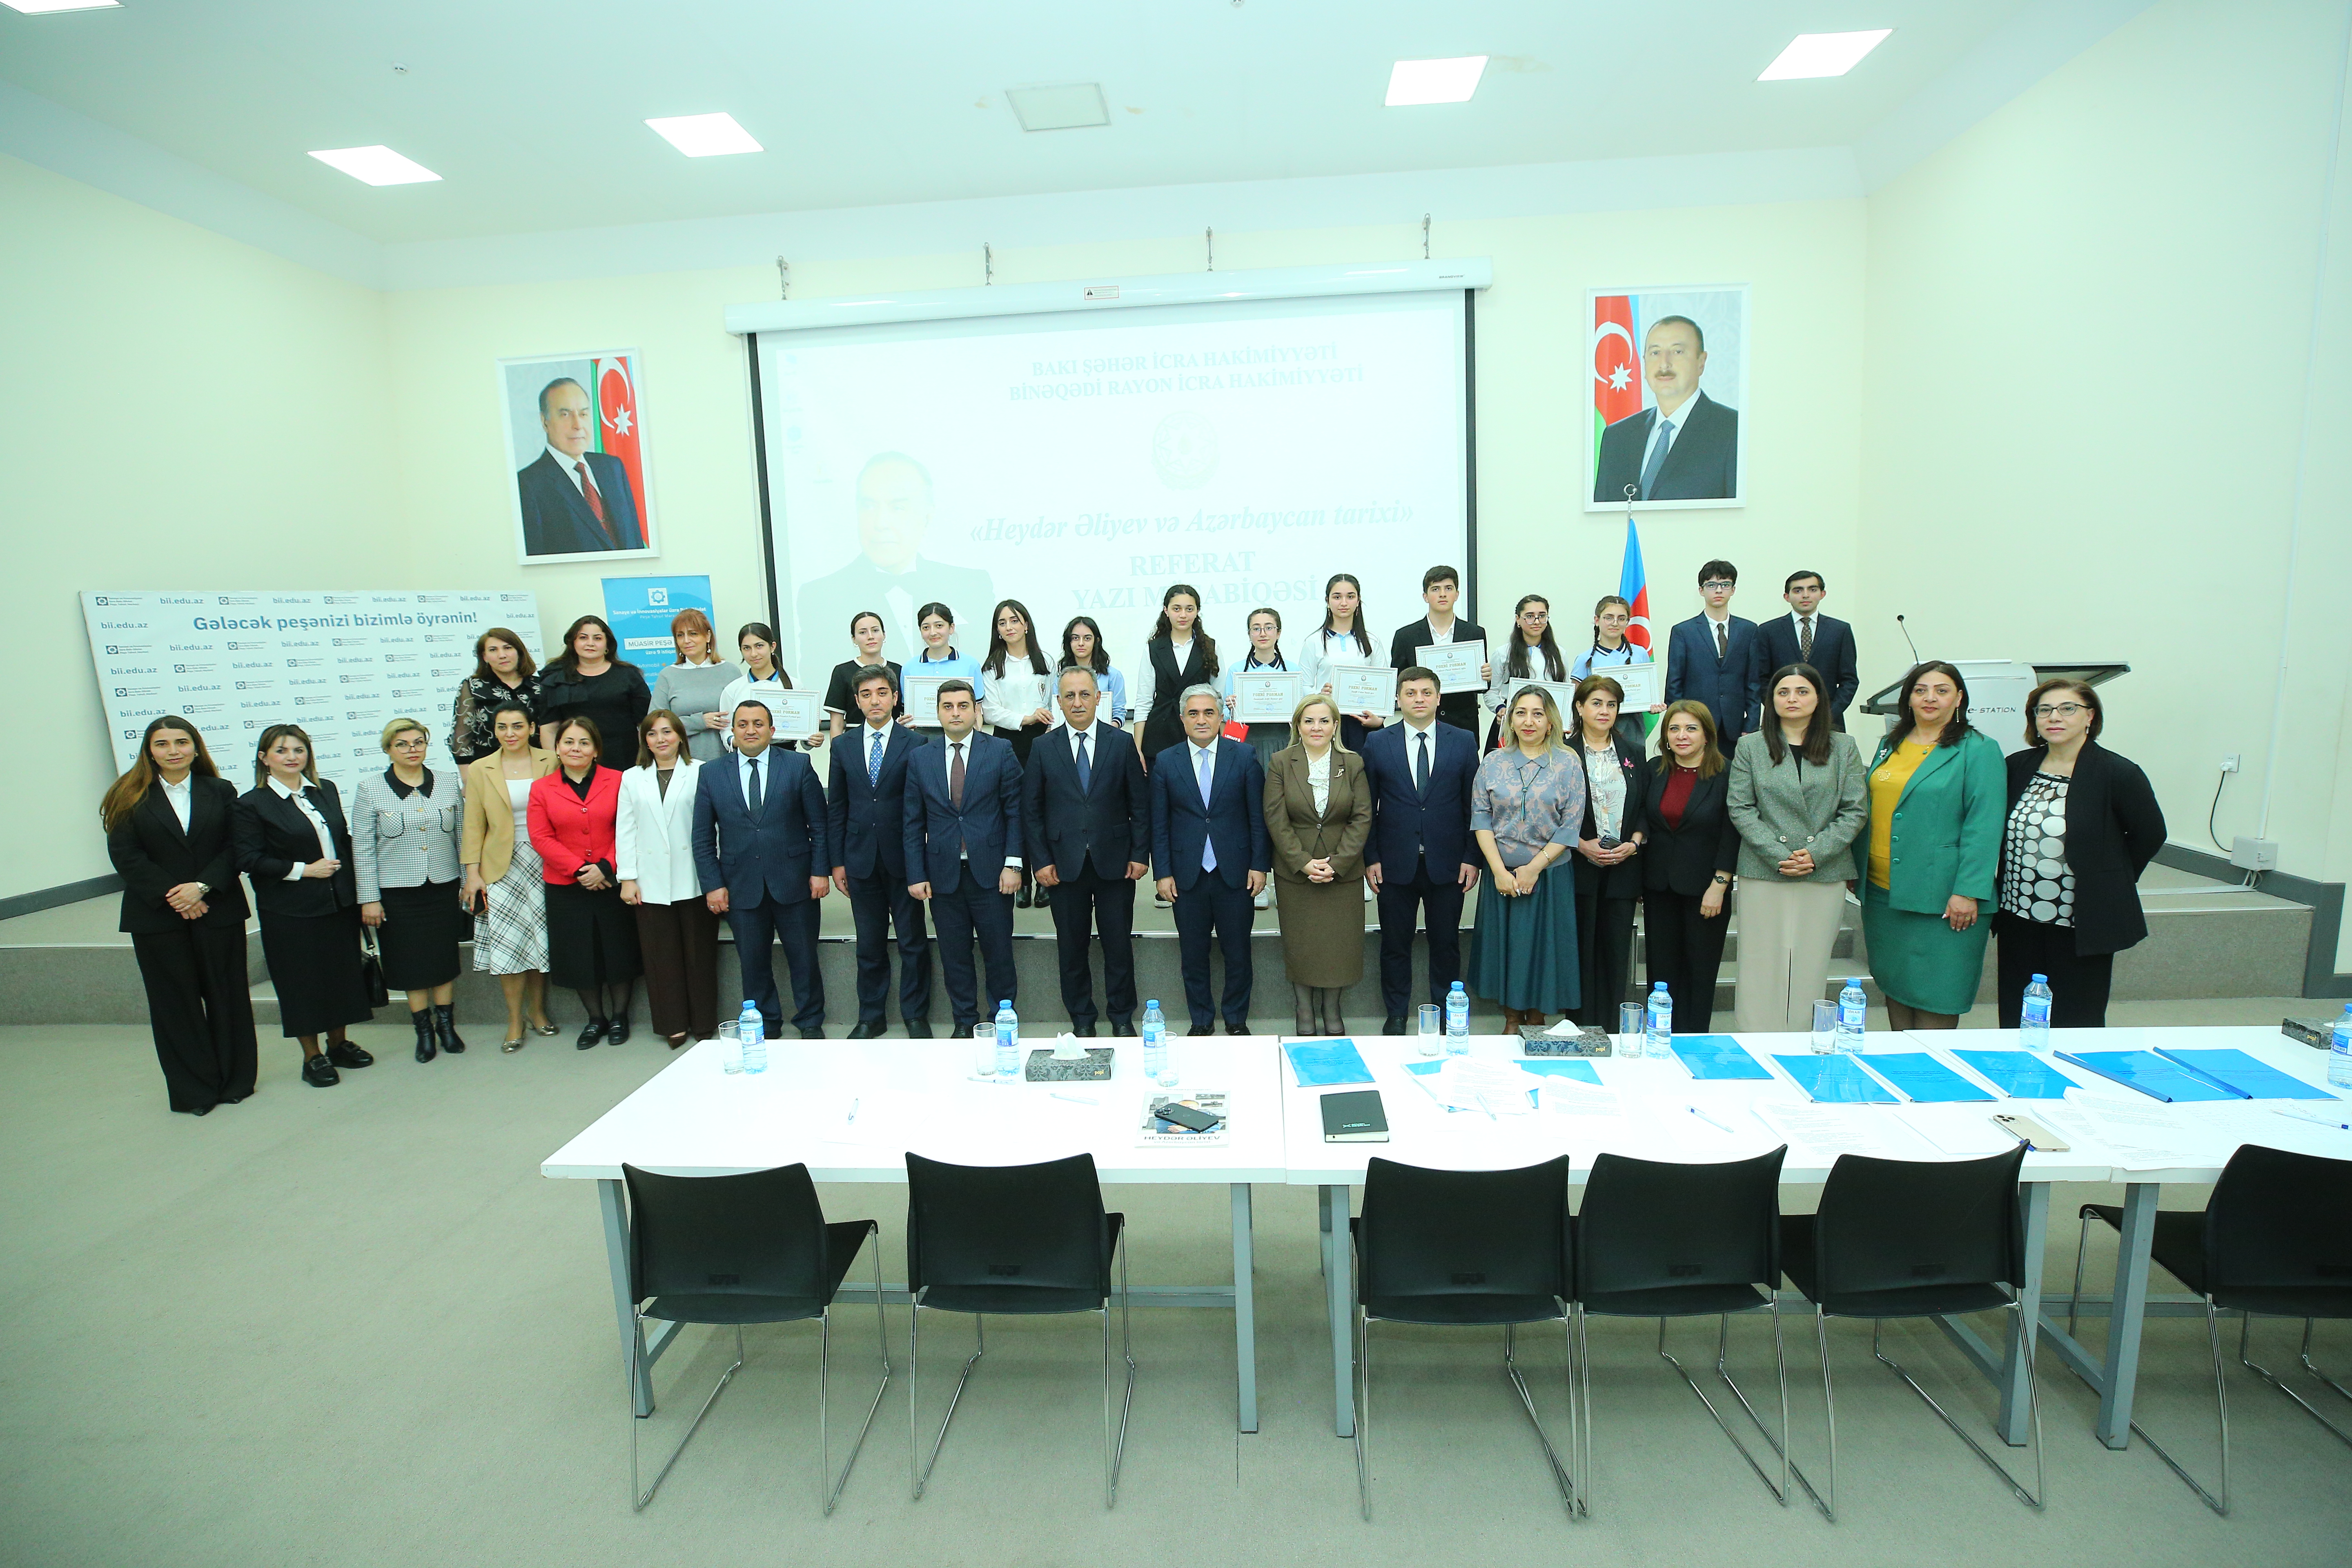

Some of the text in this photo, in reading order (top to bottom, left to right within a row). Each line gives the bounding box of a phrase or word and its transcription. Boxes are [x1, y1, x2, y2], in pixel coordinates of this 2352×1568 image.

[1032, 341, 1338, 378] BAKI ŞƏHƏR İCRA HAKİMİYYƏTİ
[1009, 363, 1364, 402] BİNƏQƏDİ RAYON İCRA HAKİMİYYƏTİ
[970, 499, 1414, 547] «Heydər Əliyev və Azərbaycan tarixi»
[1129, 551, 1256, 577] REFERAT
[1071, 584, 1135, 610] YAZI
[193, 612, 477, 631] Gələcək peşənizi bizimlə öyrənin!
[120, 708, 167, 717] bii.edu.az
[198, 724, 229, 732] .edu.az
